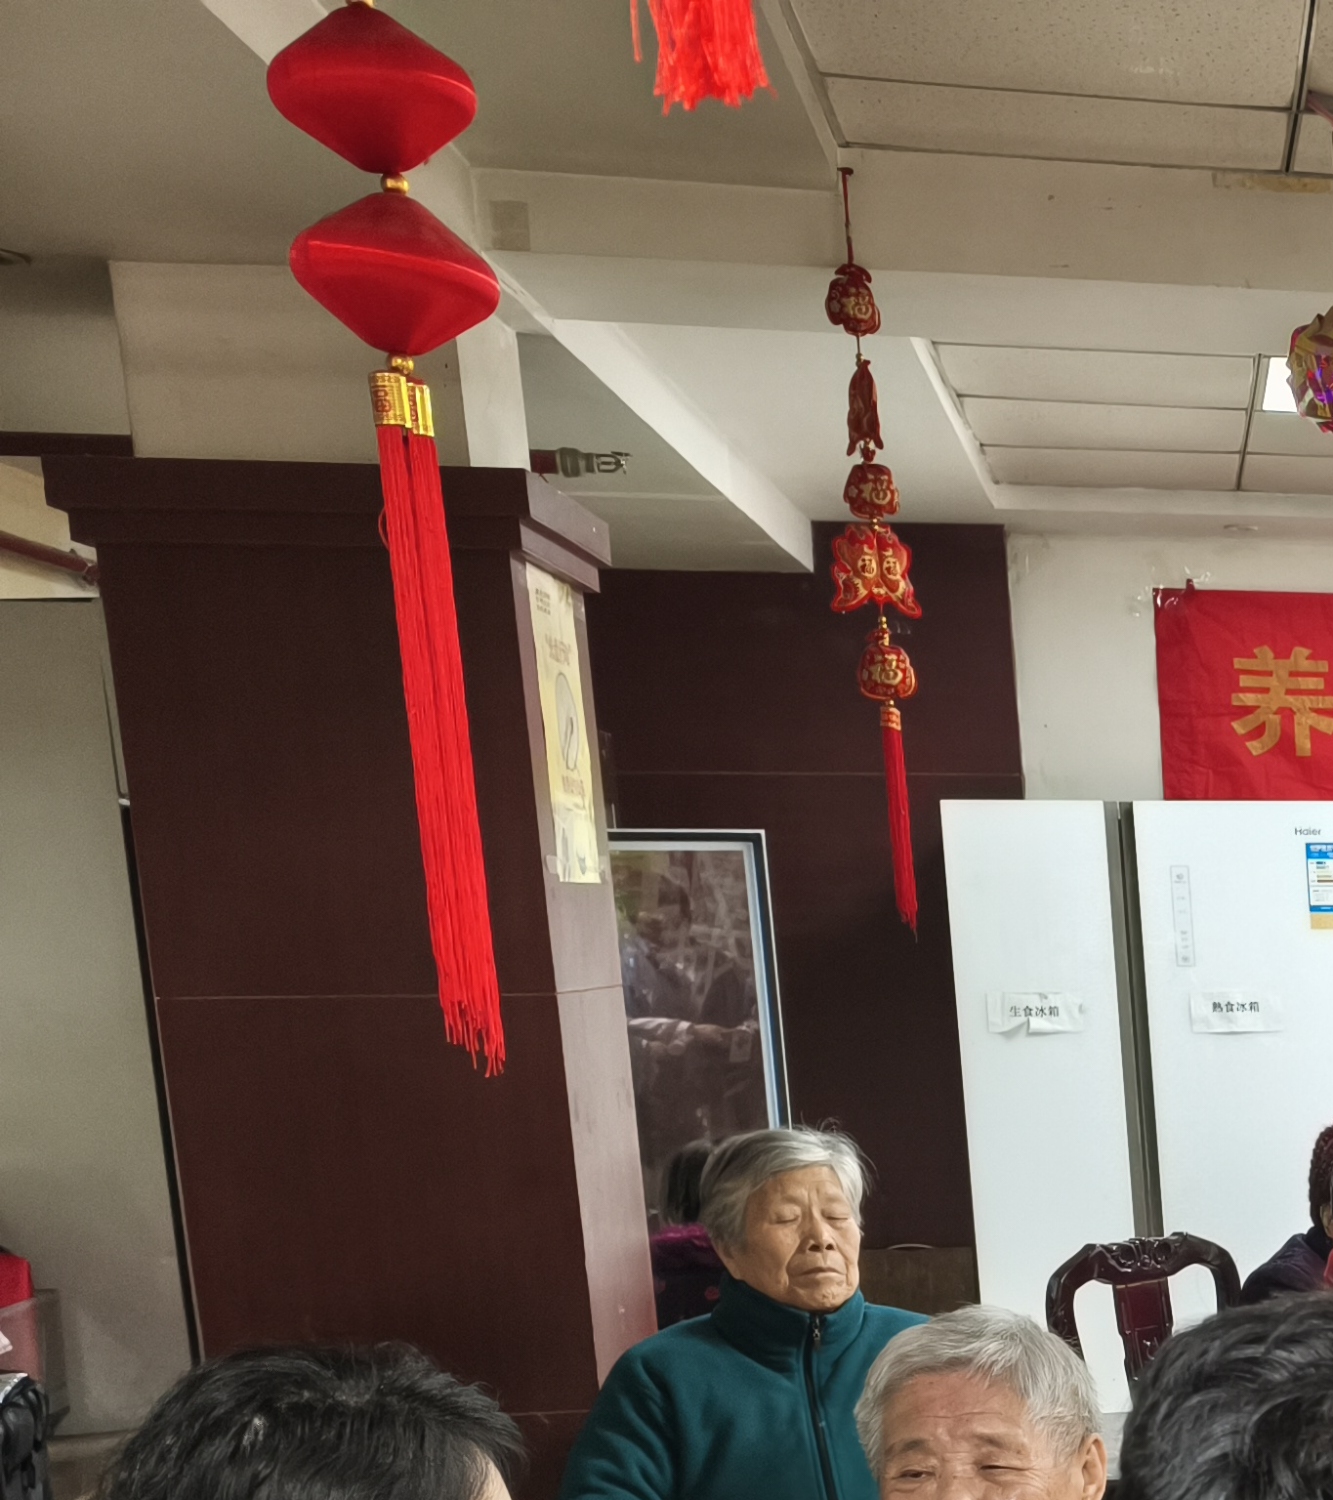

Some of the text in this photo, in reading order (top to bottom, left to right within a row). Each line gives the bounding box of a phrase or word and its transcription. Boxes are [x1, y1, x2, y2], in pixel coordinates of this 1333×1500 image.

[1294, 826, 1322, 836] Haier
[1009, 1005, 1060, 1018] 生食冰箱
